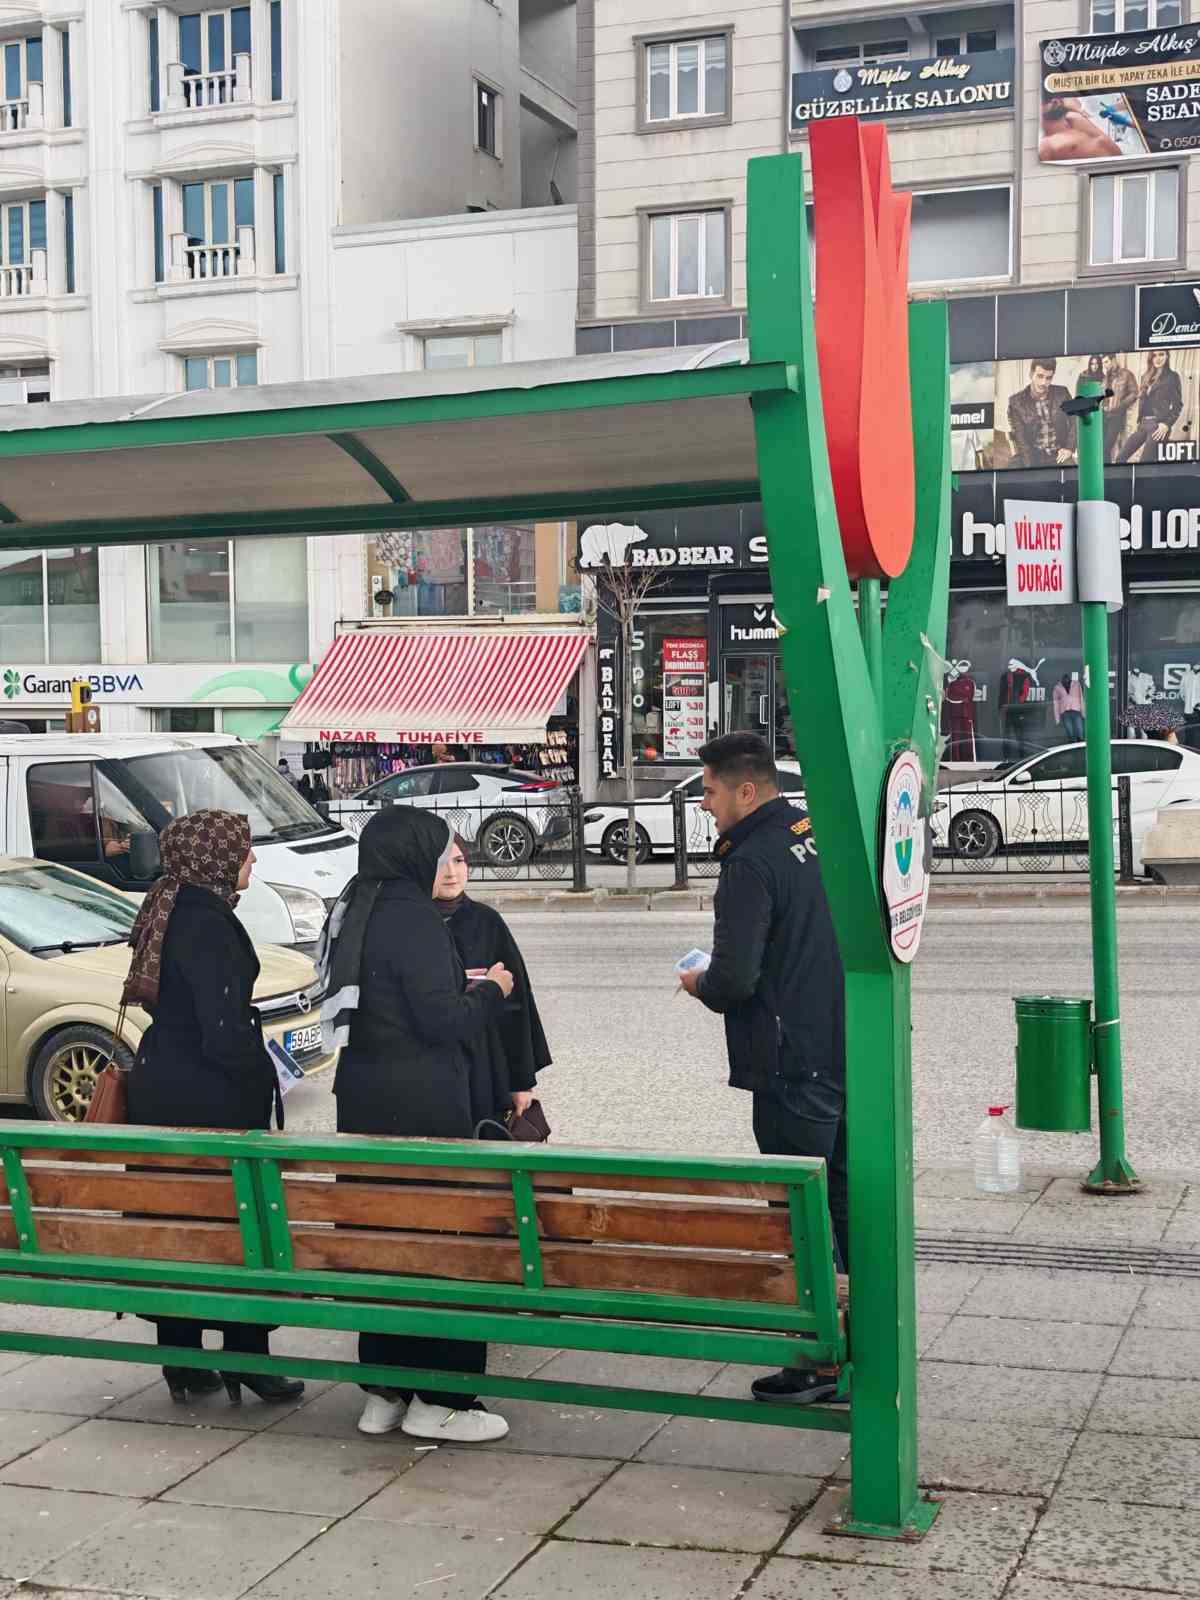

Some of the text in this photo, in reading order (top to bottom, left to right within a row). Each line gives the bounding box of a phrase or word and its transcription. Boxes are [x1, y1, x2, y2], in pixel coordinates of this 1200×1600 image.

[1064, 32, 1197, 64] Müjde Alkış
[1120, 71, 1145, 83] YAPAY
[1147, 68, 1168, 80] ZEKA
[795, 82, 1010, 120] GÜZELLİK SALONU
[1158, 442, 1195, 461] LOFT
[1014, 515, 1063, 550] VİLAYET
[631, 548, 676, 568] BAD
[678, 546, 734, 566] BEAR
[1017, 559, 1063, 593] DURAĞI
[88, 674, 143, 693] BBVA
[601, 666, 615, 774] BAD BEAR
[319, 729, 485, 743] NAZAR TUHAFİYE
